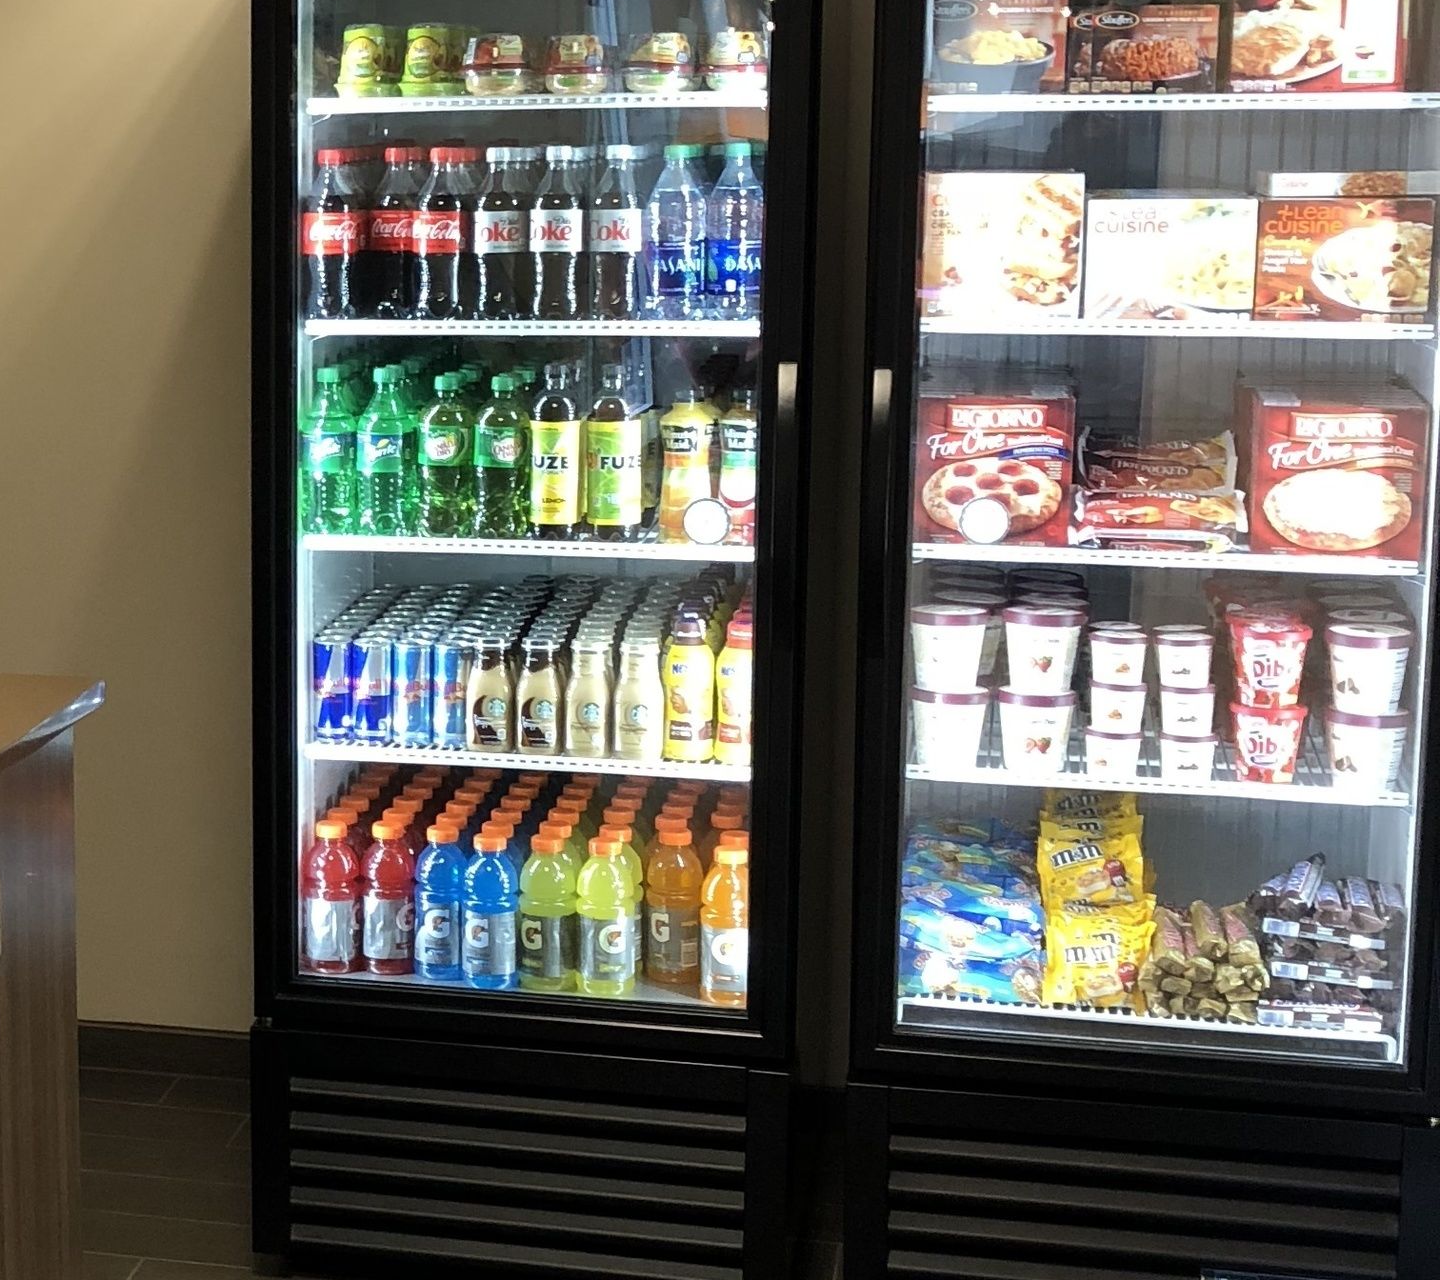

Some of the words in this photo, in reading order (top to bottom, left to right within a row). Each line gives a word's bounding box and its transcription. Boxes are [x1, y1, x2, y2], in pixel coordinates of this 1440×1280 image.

[481, 220, 521, 243] oke
[1095, 219, 1170, 234] cuisine
[1265, 220, 1344, 234] cuisine
[659, 257, 702, 274] ASANI
[722, 254, 762, 274] DASA
[951, 408, 1045, 428] DIGIORNO
[927, 432, 963, 459] For
[961, 428, 1005, 455] One
[1268, 441, 1306, 470] For
[1306, 439, 1353, 465] One
[1117, 460, 1140, 470] HOT
[1141, 461, 1190, 476] POCKETS
[424, 908, 450, 939] G
[464, 917, 490, 949] G
[520, 919, 543, 950] G
[598, 923, 627, 954] G
[650, 912, 671, 943] G
[710, 933, 741, 965] G
